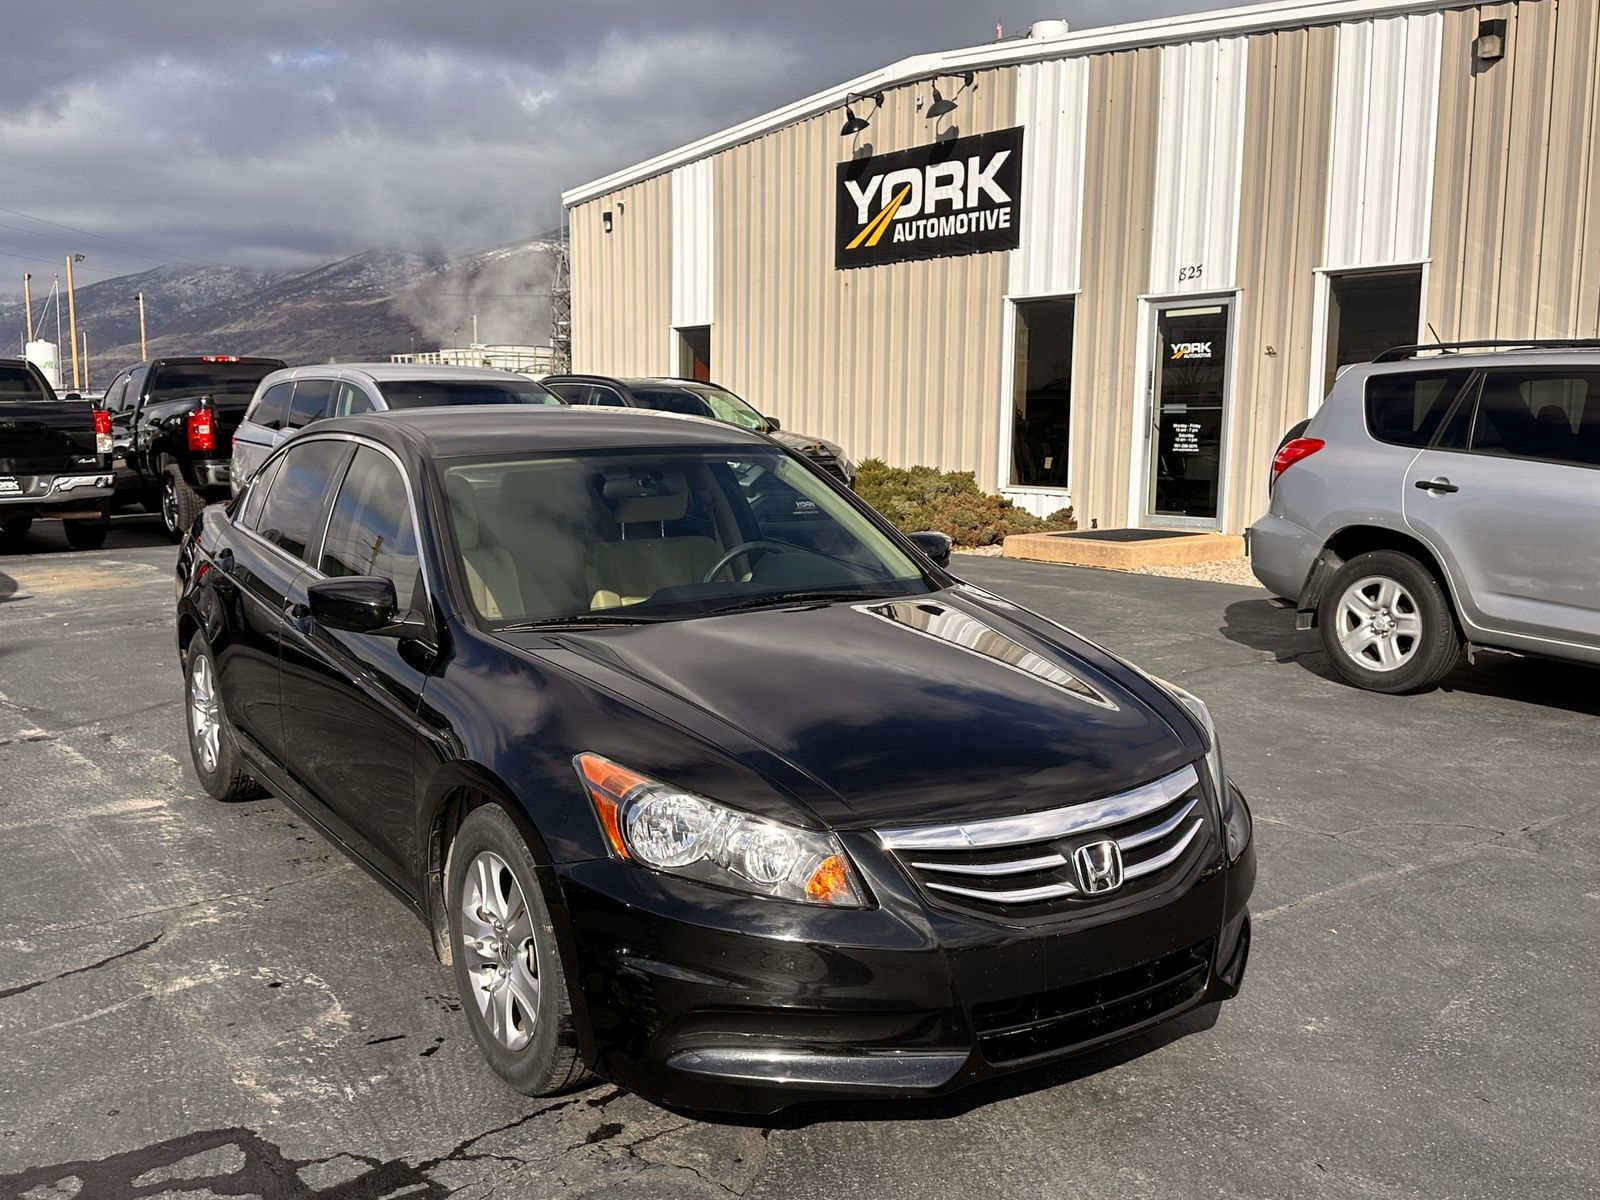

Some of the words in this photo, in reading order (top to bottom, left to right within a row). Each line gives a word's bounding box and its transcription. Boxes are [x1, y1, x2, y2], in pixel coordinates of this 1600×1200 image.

[844, 150, 1012, 225] YORK
[893, 207, 1011, 243] AUTOMOTIVE
[1179, 264, 1203, 283] 825
[1170, 342, 1212, 354] YORK
